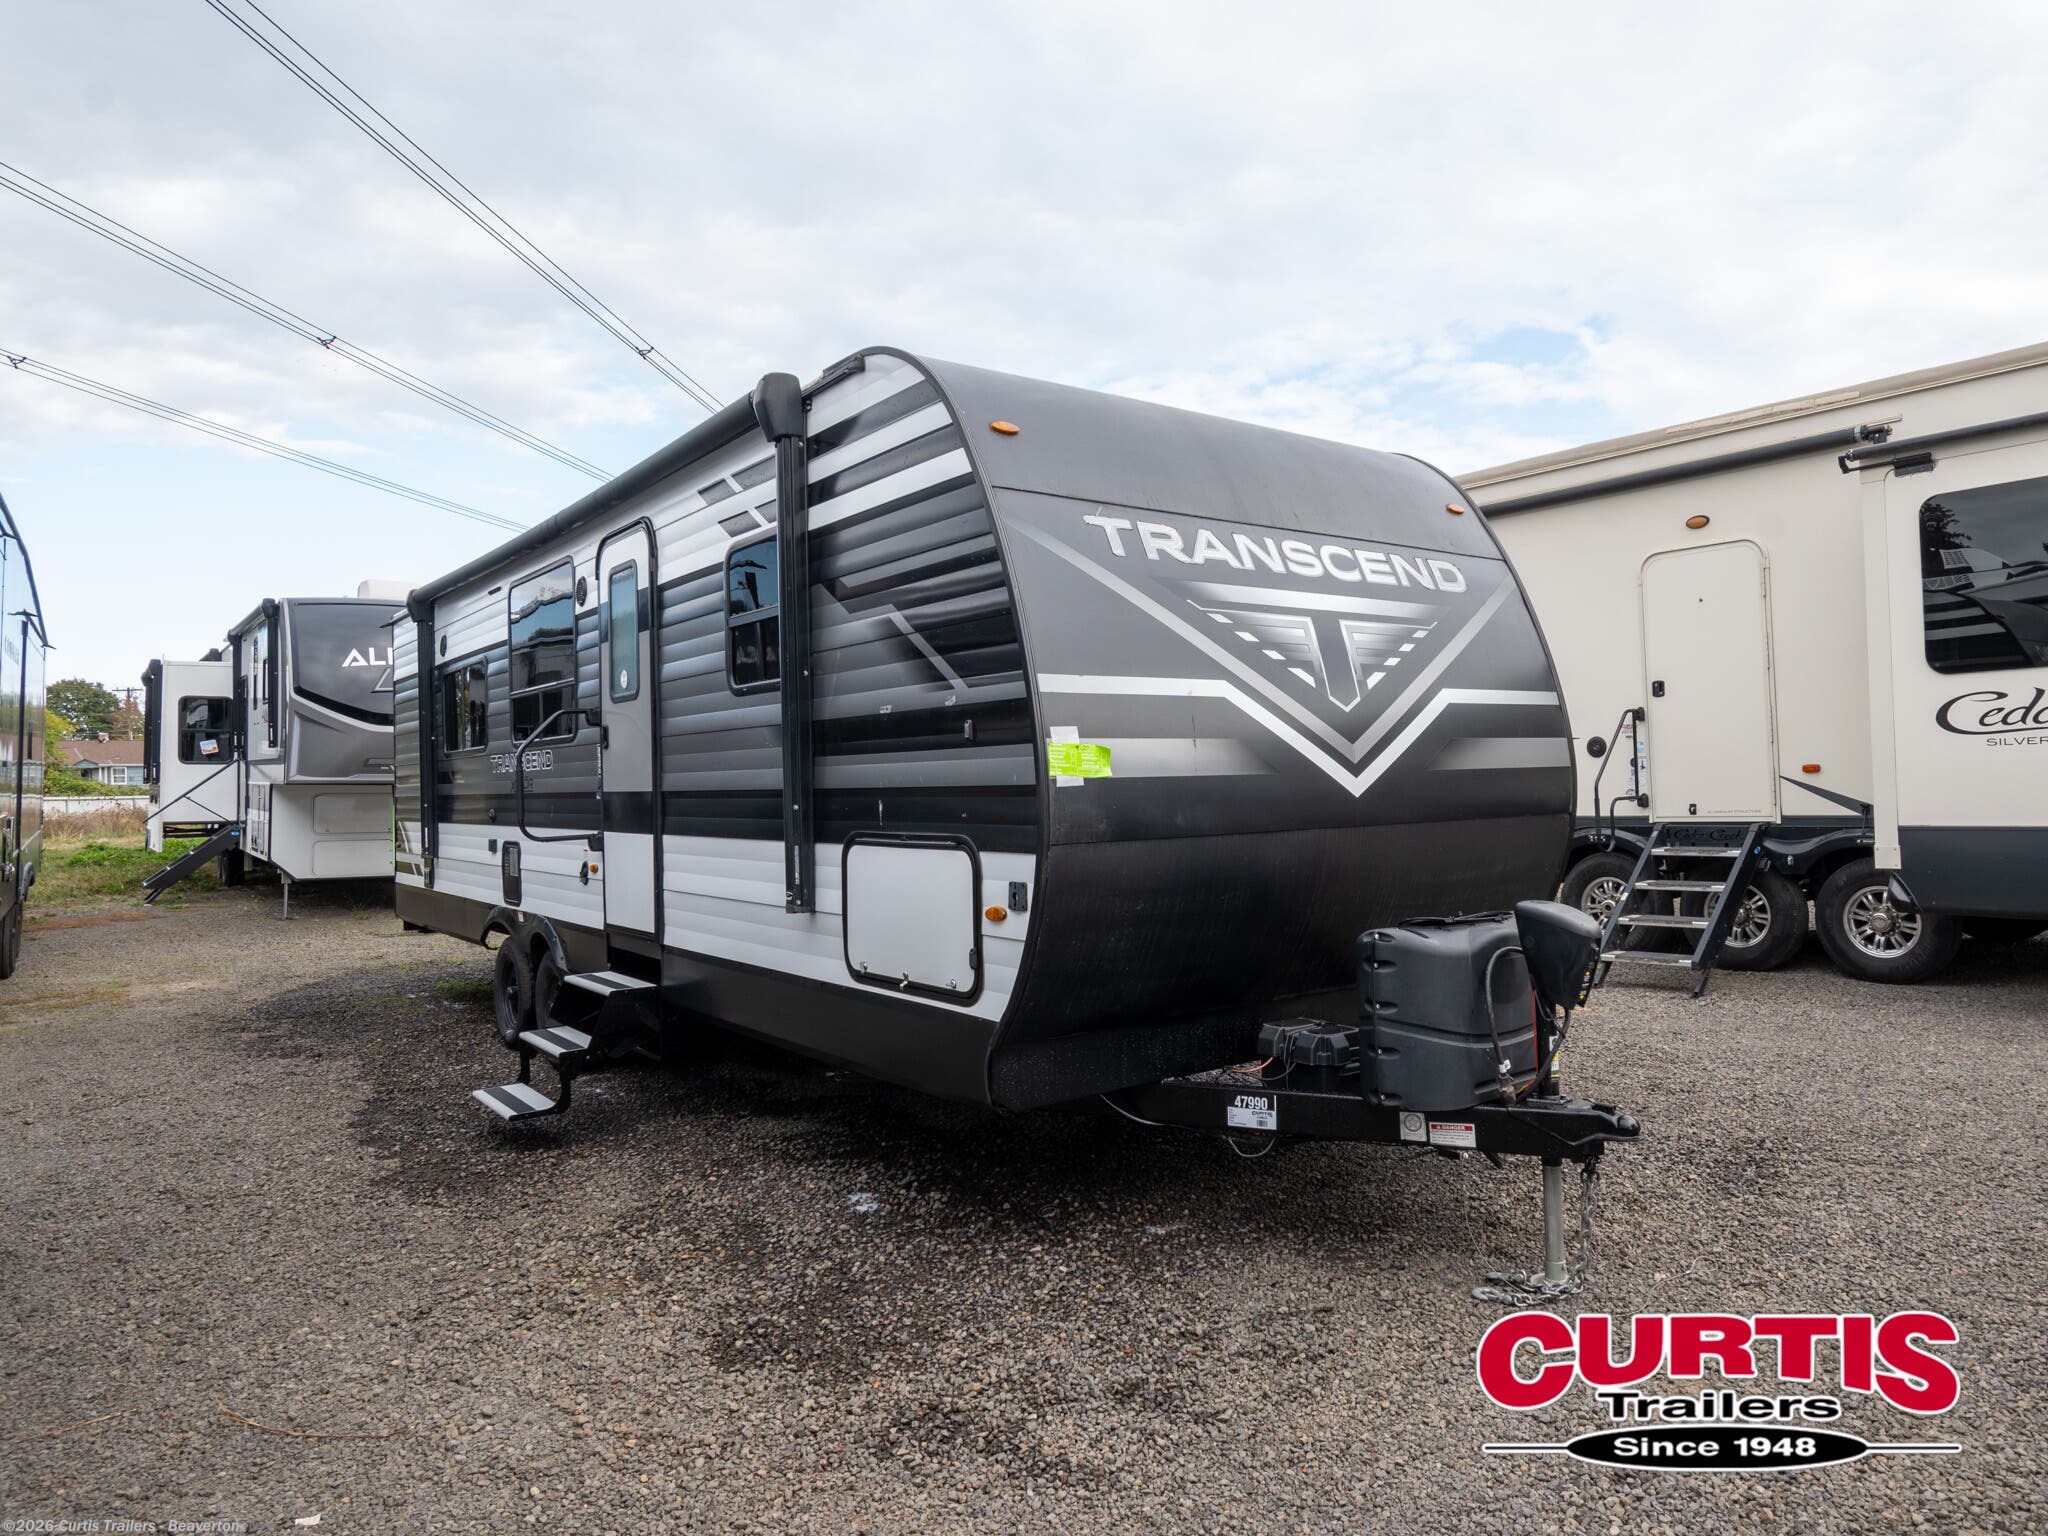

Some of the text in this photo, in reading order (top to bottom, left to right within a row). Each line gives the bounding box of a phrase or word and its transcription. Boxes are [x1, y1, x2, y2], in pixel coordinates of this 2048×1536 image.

[1083, 514, 1467, 593] TRANSCEND
[489, 749, 553, 773] TRANCEND
[1234, 1095, 1268, 1110] 47990
